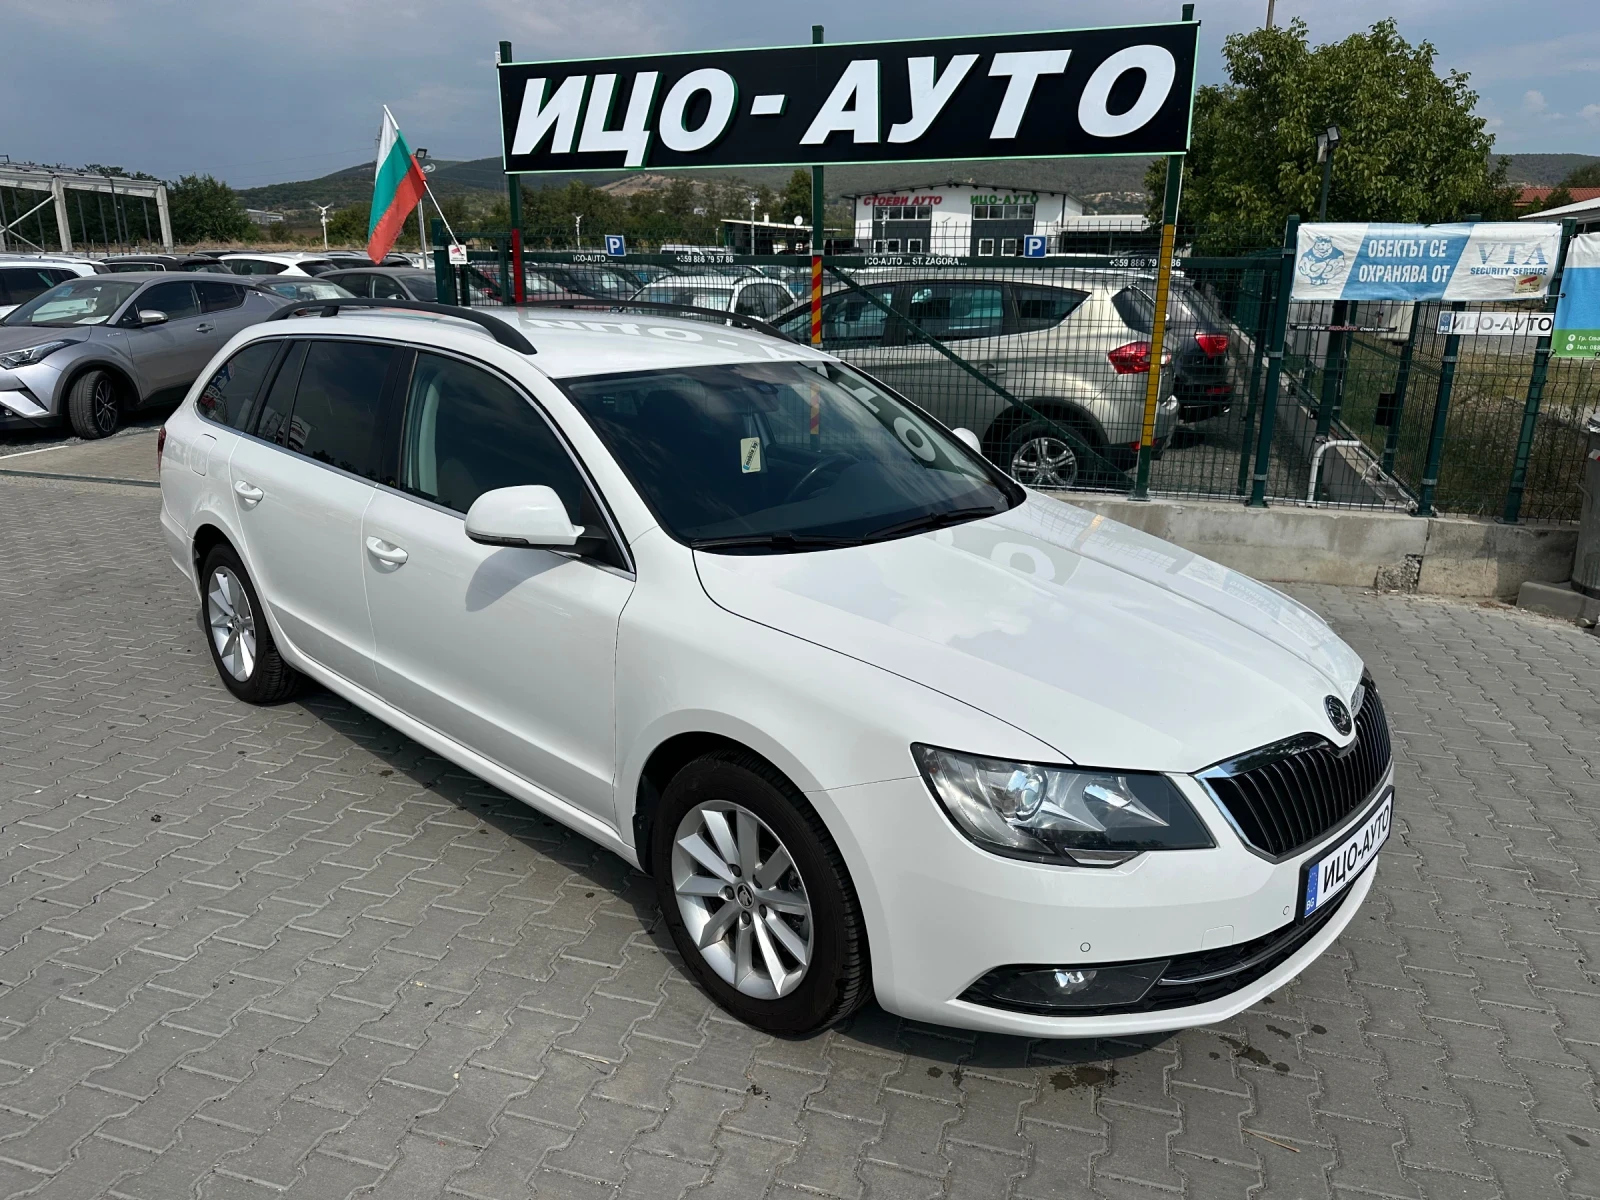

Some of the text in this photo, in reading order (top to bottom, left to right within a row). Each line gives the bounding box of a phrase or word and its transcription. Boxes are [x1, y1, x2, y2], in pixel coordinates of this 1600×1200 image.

[863, 196, 943, 206] СТОЕВИ АУТО
[609, 238, 620, 254] P
[1028, 238, 1042, 256] P
[1368, 239, 1448, 258] ОБЕКТЪТ СЕ
[1475, 242, 1549, 265] VTA
[716, 256, 724, 264] 57
[725, 256, 734, 264] 86
[925, 257, 959, 266] ZAGORA
[1359, 264, 1450, 283] ОХРАНЯВА ОТ
[1470, 267, 1548, 276] SECURITY SERVICE
[1453, 316, 1553, 332] ИЦО-АУТО
[1323, 804, 1390, 894] ИЦО-АУТО
[1306, 897, 1315, 911] BG
